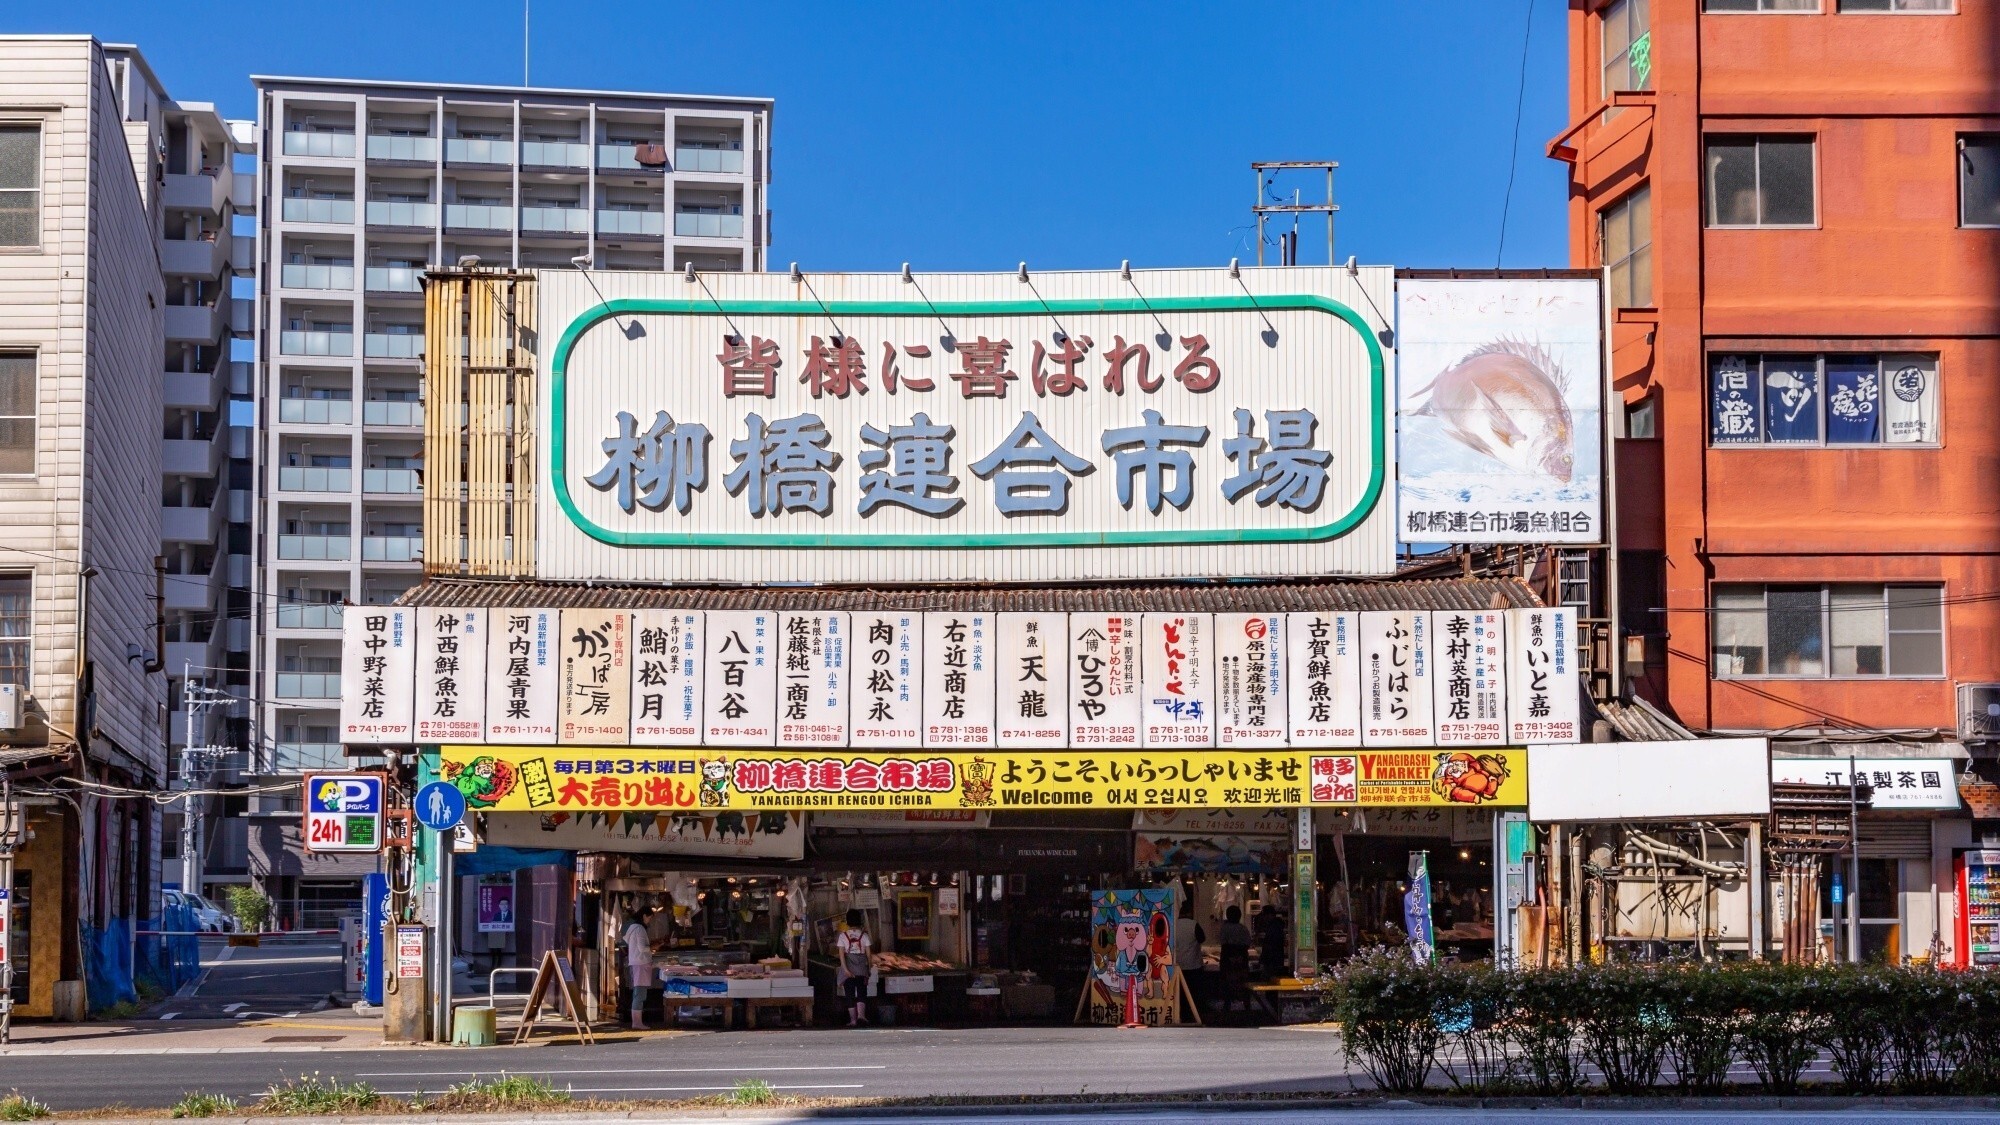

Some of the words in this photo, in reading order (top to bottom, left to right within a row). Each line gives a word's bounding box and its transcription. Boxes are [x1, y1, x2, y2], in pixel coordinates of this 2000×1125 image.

[716, 334, 1222, 399] 皆様に喜ばれる
[583, 408, 1332, 518] 柳橋連合市場
[1407, 510, 1592, 533] 柳橋連合市場魚組合
[393, 612, 403, 648] 新鮮野菜
[465, 612, 475, 634] 鮮魚
[812, 617, 822, 656] 有限会社
[1026, 621, 1039, 648] 鮮魚
[1336, 617, 1346, 656] 業務用一式
[1531, 613, 1543, 647] 鮮魚の
[537, 613, 547, 666] 高級新鮮野菜
[614, 614, 624, 667] 馬刺し専門店
[669, 615, 680, 674] 手作りの菓子
[755, 617, 765, 666] 野菜・果実
[973, 617, 983, 671] 鮮魚・淡水魚
[1414, 616, 1424, 677] 天然だし専門店
[1486, 615, 1496, 689] 味の明太子
[1554, 613, 1565, 674] 業務用高級鮮魚
[360, 615, 388, 718] 田中野菜店
[433, 613, 460, 718] 仲西鮮魚店
[506, 615, 531, 719] 河内屋青果
[784, 616, 811, 720] 佐藤純一商店
[867, 619, 895, 722] 肉の松永
[942, 618, 967, 719] 右近商店
[1109, 635, 1121, 696] 辛しめんたい
[1269, 617, 1279, 696] 昆布だし辛子明太子
[1307, 617, 1332, 723] 古賀鮮魚店
[1386, 617, 1409, 720] ふじはら
[1446, 615, 1471, 720] 幸村英商店
[718, 630, 750, 719] 八百谷
[1017, 655, 1048, 718] 天龍
[1077, 654, 1107, 720] ひろや
[1246, 640, 1267, 727] 原口海産物専門店
[1527, 649, 1551, 718] いと嘉
[359, 725, 407, 733] 741-8787
[577, 726, 623, 734] 715-1400
[648, 727, 695, 735] 761-5058
[722, 728, 768, 736] 761-4341
[868, 729, 915, 737] 751-0110
[941, 726, 988, 734] 781-1386
[941, 735, 988, 743] 731-2136
[1014, 730, 1061, 738] 741-8256
[1087, 726, 1135, 734] 761-3123
[1087, 735, 1135, 743] 731-2242
[1161, 726, 1209, 734] 761-2117
[1161, 735, 1209, 743] 713-1038
[1307, 729, 1355, 737] 712-1822
[1526, 722, 1573, 730] 781-3402
[1526, 731, 1573, 739] 771-7233
[553, 759, 696, 775] 毎月第3木曜日
[735, 759, 953, 791] 柳橋連合市場
[1000, 757, 1302, 783] ようこそ、いらっしゃいませ
[1313, 758, 1355, 775] 博多
[1327, 774, 1339, 784] の
[1376, 767, 1430, 779] MARKET
[521, 758, 553, 807] 激安
[557, 776, 697, 807] 大売り出し
[1002, 790, 1093, 805] Welcome
[1107, 788, 1138, 805] 어서
[1144, 788, 1208, 805] 오십시오
[1223, 788, 1302, 804] 欢迎光临
[1313, 783, 1355, 800] 台所
[346, 803, 371, 811] タイムパーク
[751, 795, 833, 806] YANAGIBASHI
[838, 795, 885, 805] RENGOU
[890, 795, 932, 805] ICHIBA
[312, 818, 342, 843] 24h
[1186, 820, 1200, 828] TEL
